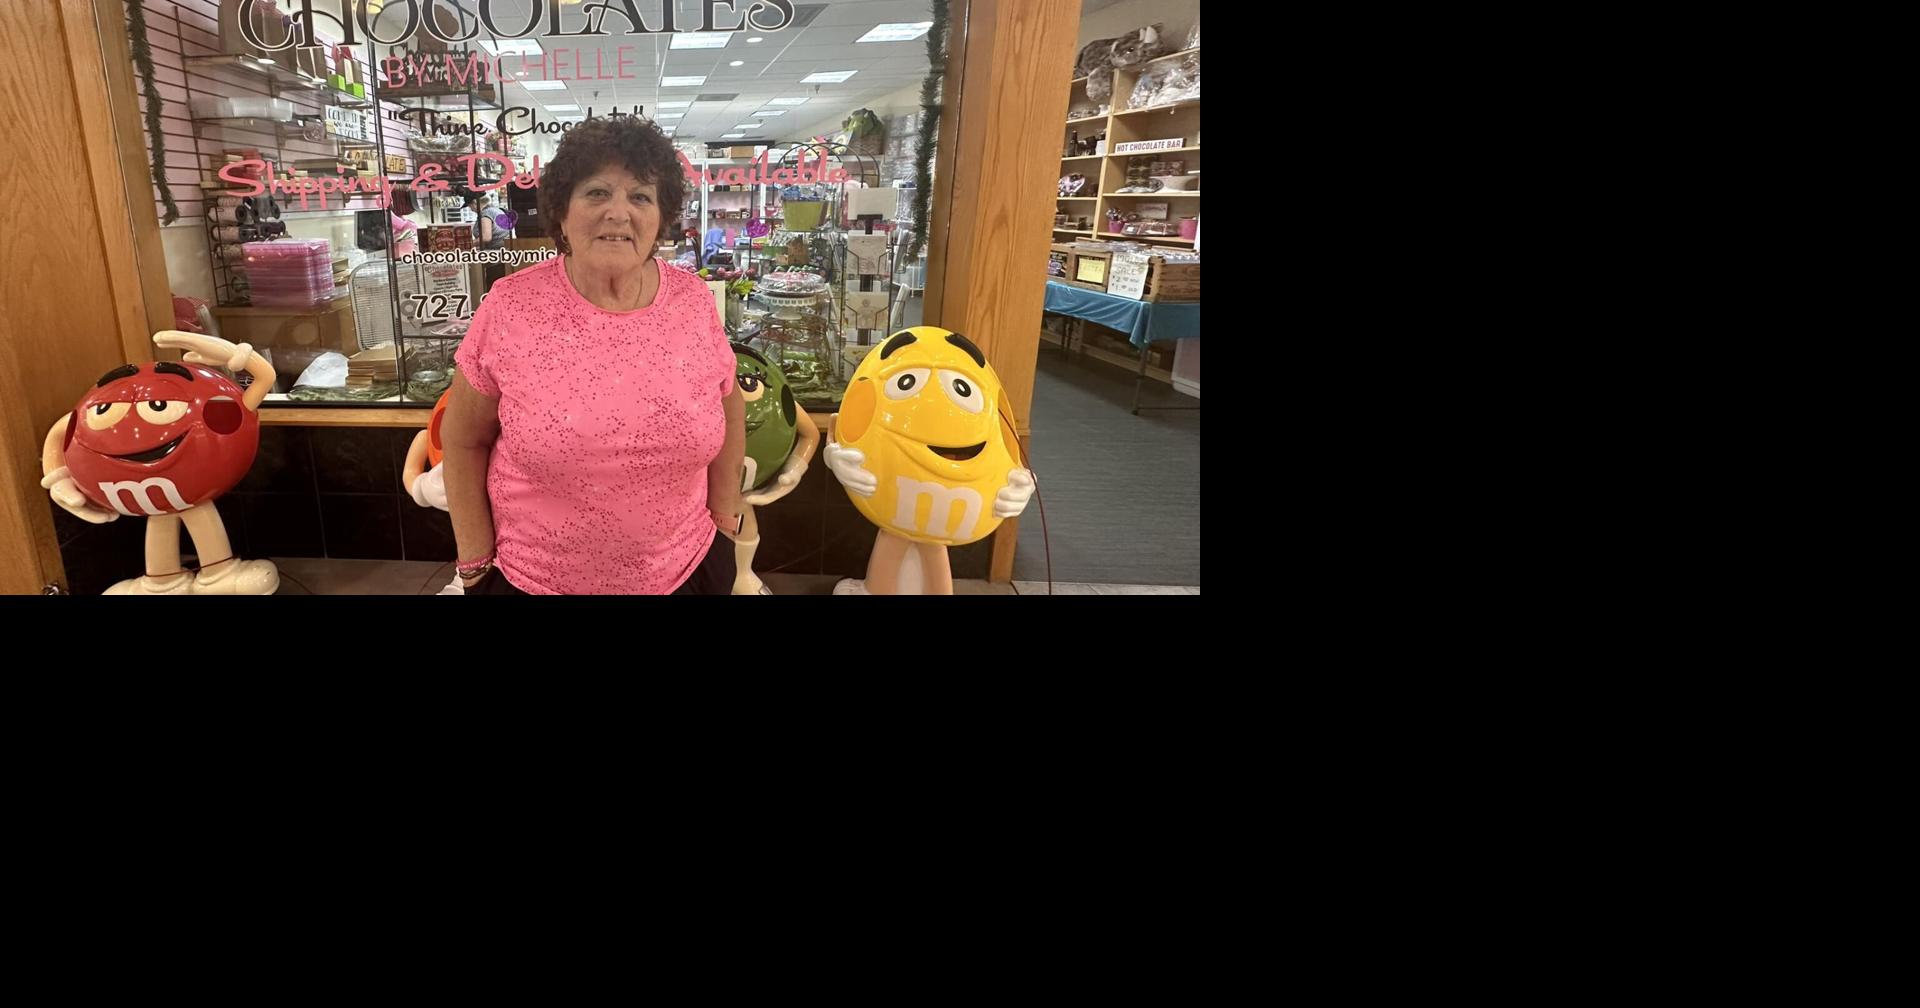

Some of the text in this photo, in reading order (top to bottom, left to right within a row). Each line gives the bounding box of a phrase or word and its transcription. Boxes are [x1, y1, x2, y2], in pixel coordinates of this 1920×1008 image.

[386, 52, 428, 88] BY
[445, 46, 636, 87] MICHELLE
[1116, 140, 1181, 152] HOT CHOCOLATE BAR
[218, 159, 396, 210] Shipping
[411, 162, 449, 192] &
[410, 294, 489, 320] 727.
